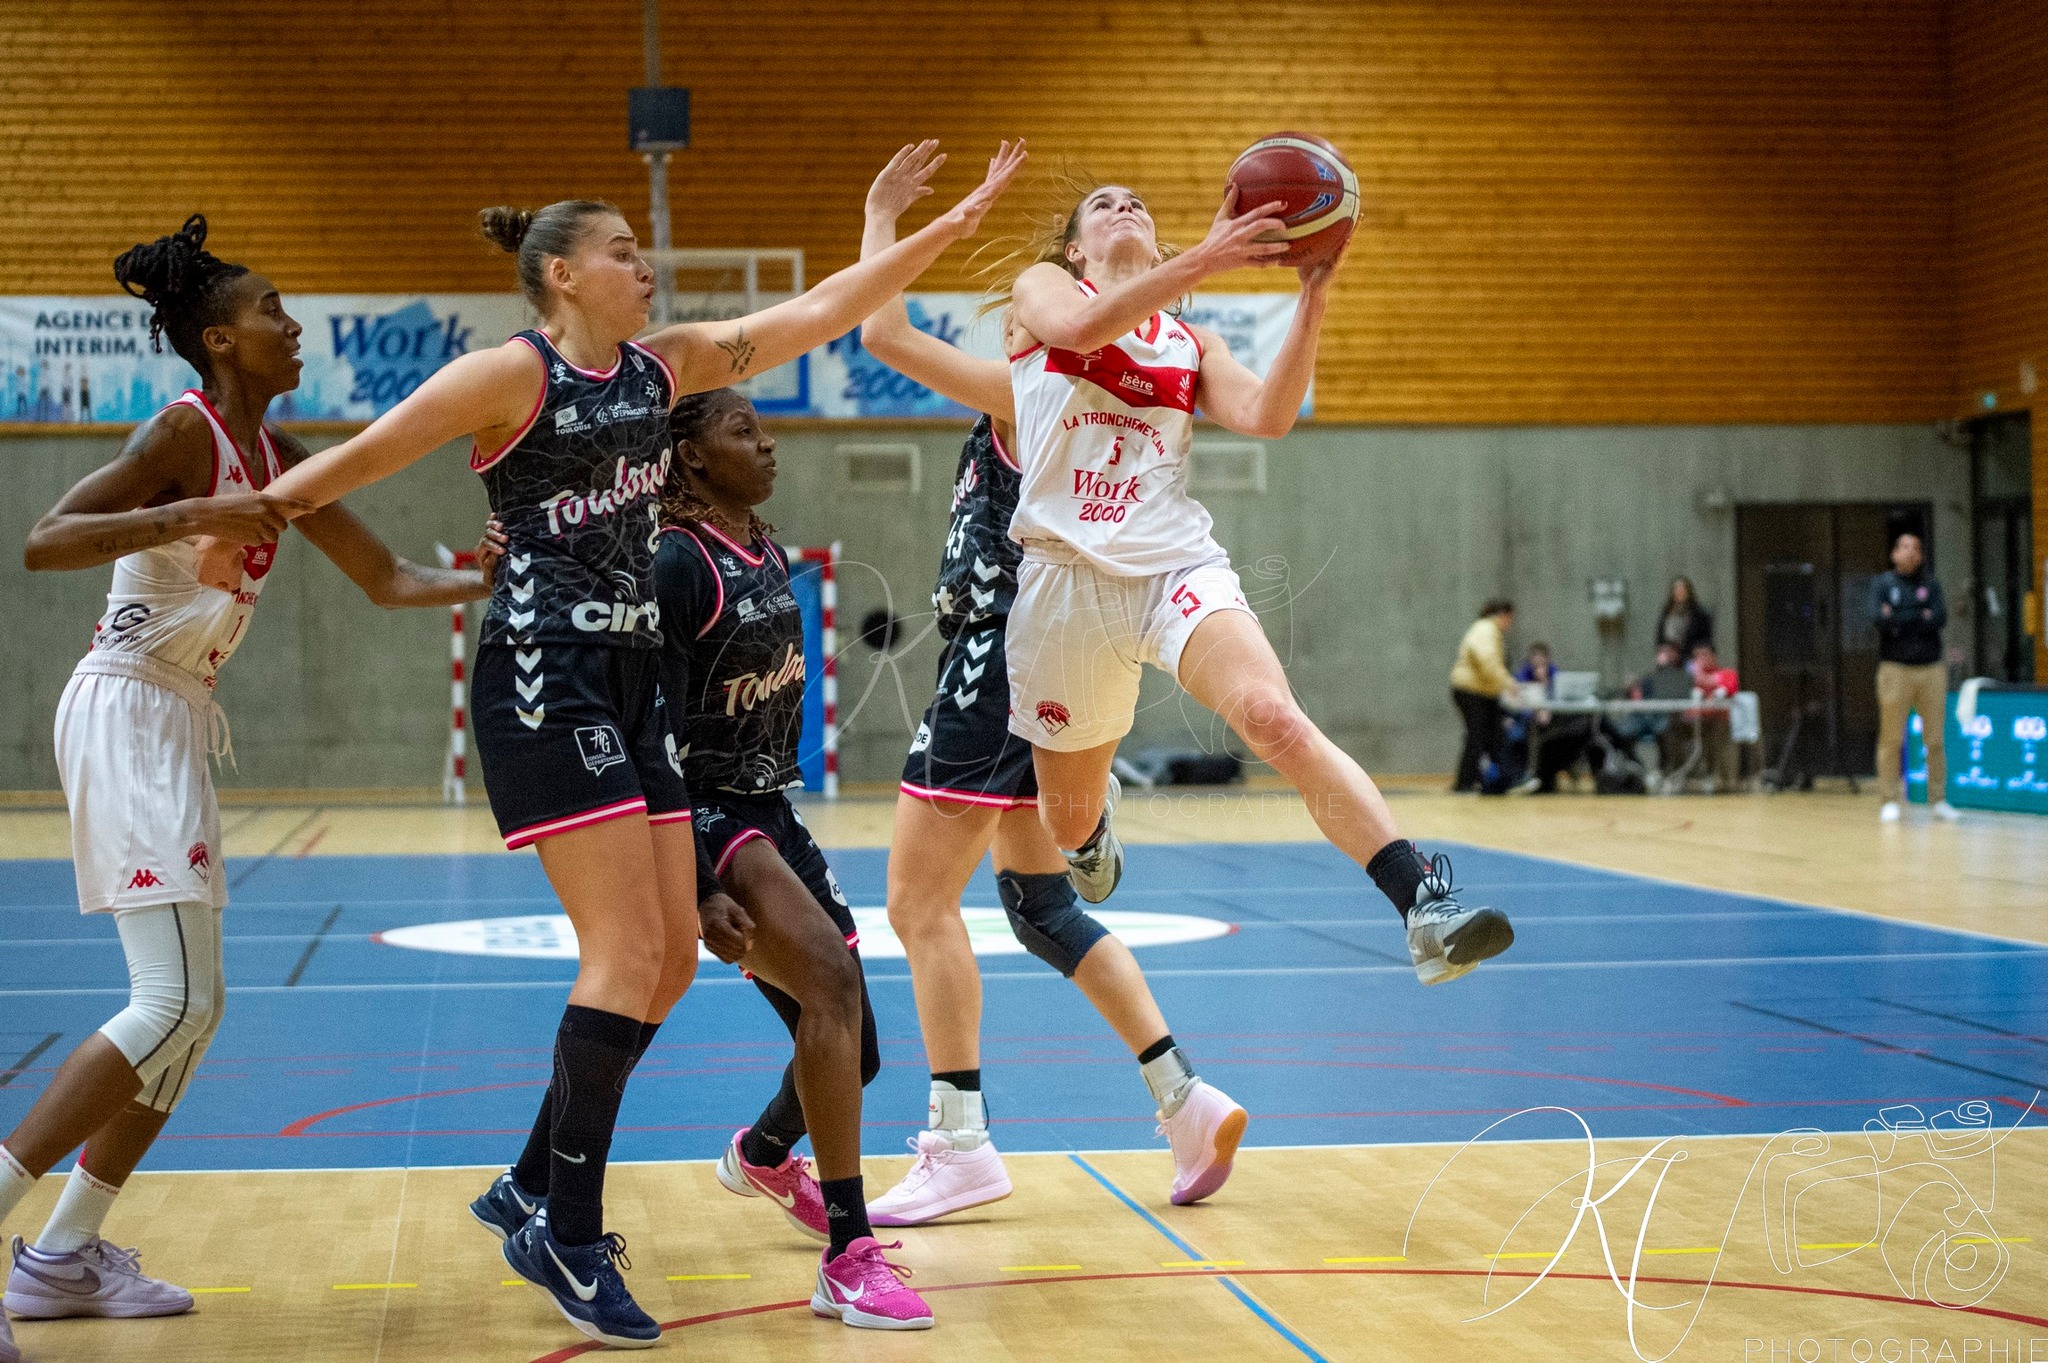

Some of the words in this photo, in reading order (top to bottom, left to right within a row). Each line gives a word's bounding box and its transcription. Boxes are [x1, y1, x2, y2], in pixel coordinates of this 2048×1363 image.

[34, 310, 133, 330] AGENCE
[328, 312, 476, 360] Work
[1121, 371, 1154, 392] isère
[555, 423, 592, 436] TOULOUSE
[1063, 415, 1080, 431] LA
[1107, 435, 1126, 466] 5
[1073, 468, 1143, 503] Work
[1078, 502, 1126, 523] 2000
[1170, 583, 1202, 619] 5
